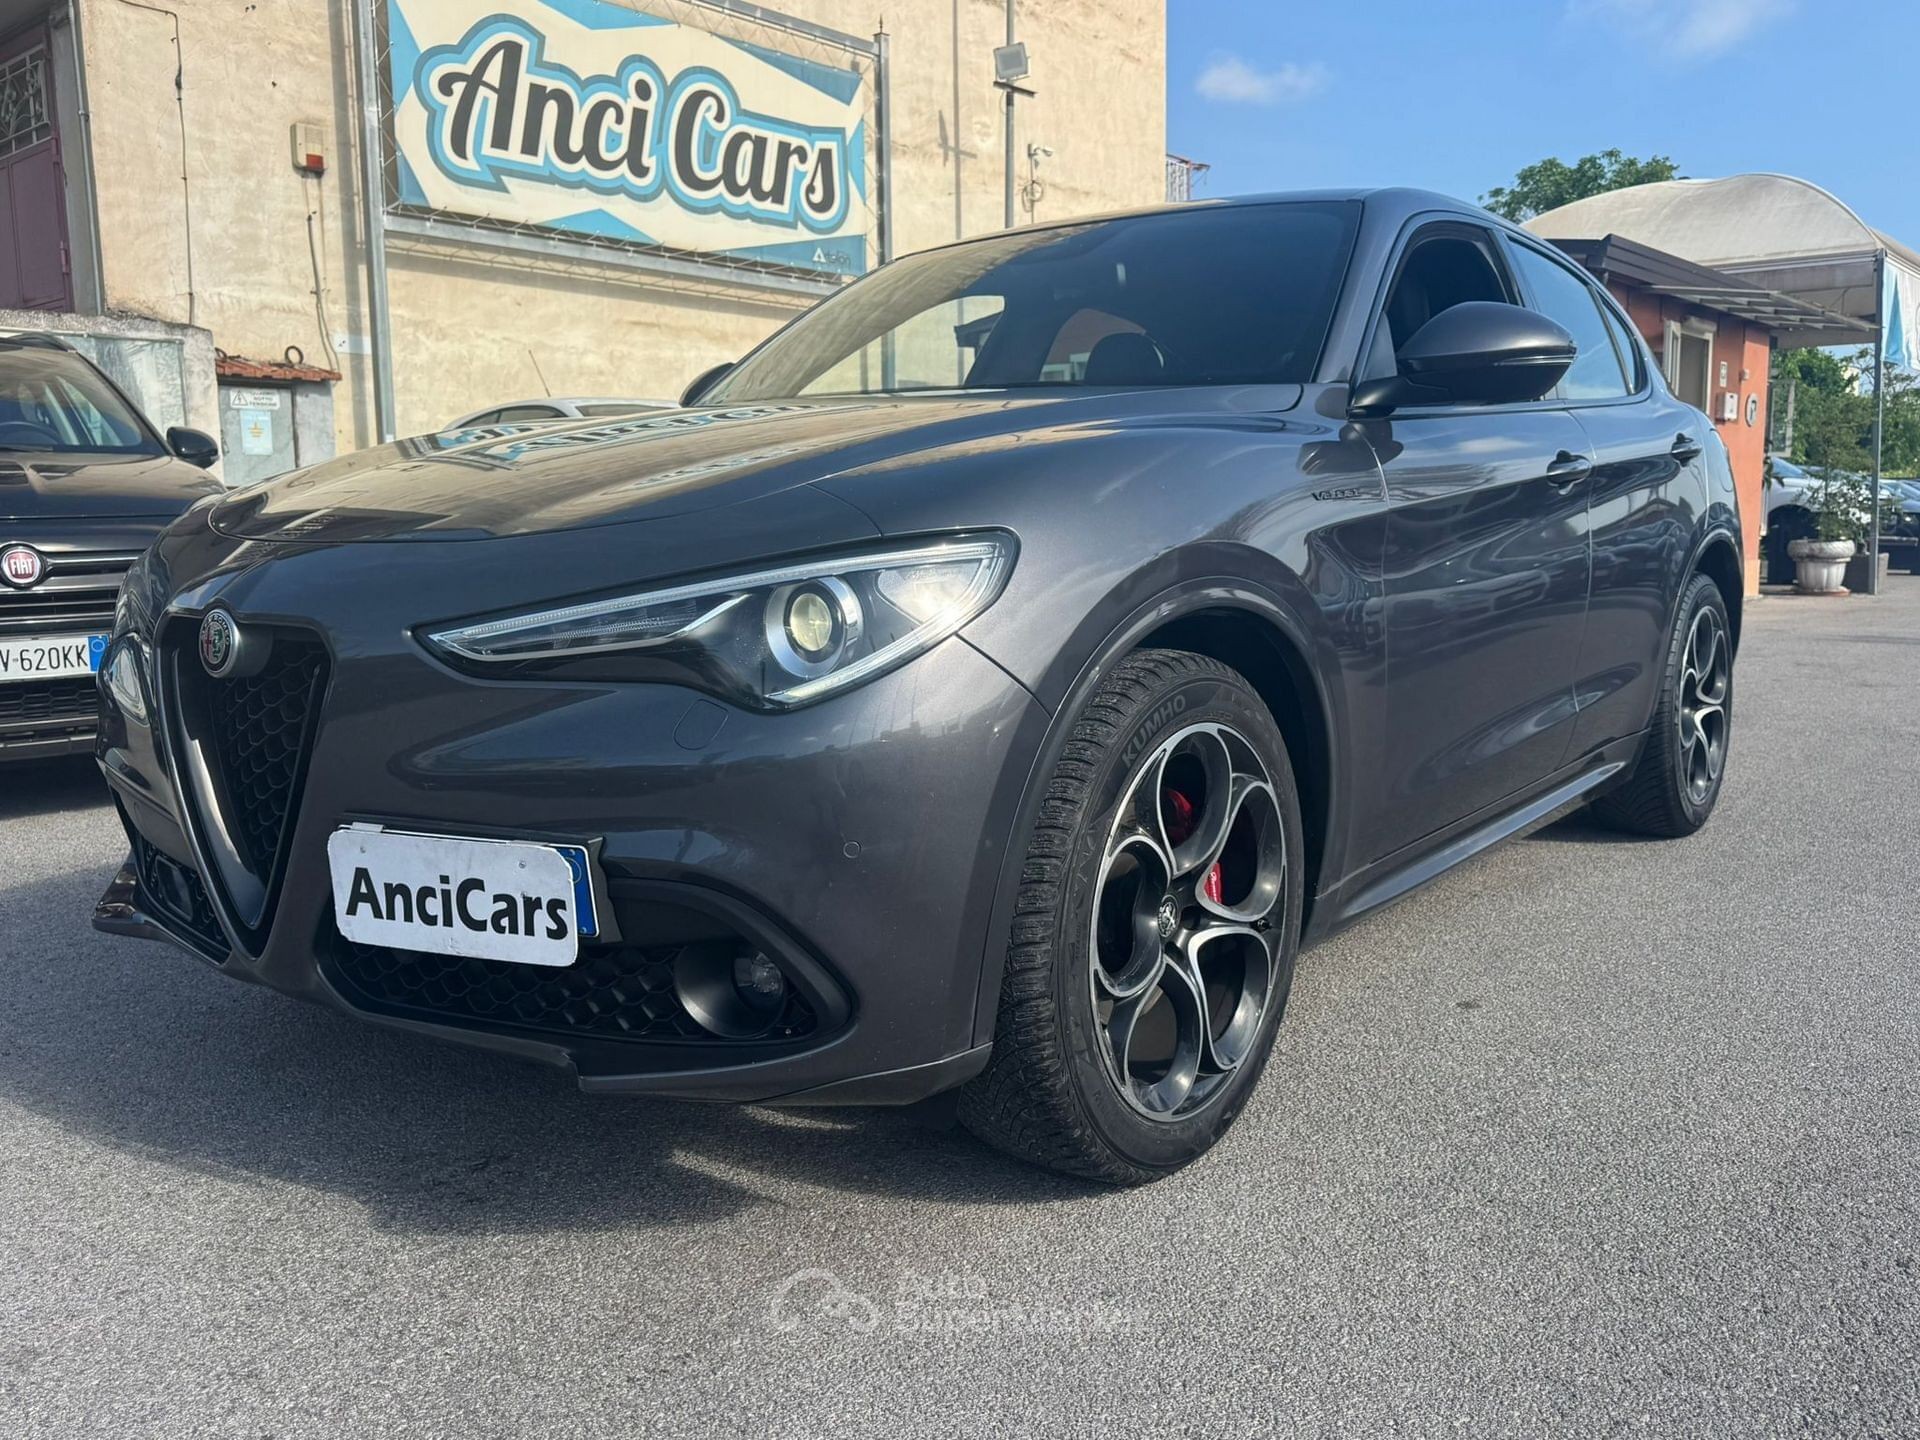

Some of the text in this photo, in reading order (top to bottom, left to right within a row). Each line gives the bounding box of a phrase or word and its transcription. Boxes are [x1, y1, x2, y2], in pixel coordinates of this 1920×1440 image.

[437, 39, 836, 214] Anci Cars
[10, 558, 33, 575] FIAT
[1120, 694, 1187, 769] KUMHO
[345, 866, 568, 941] AnciCars
